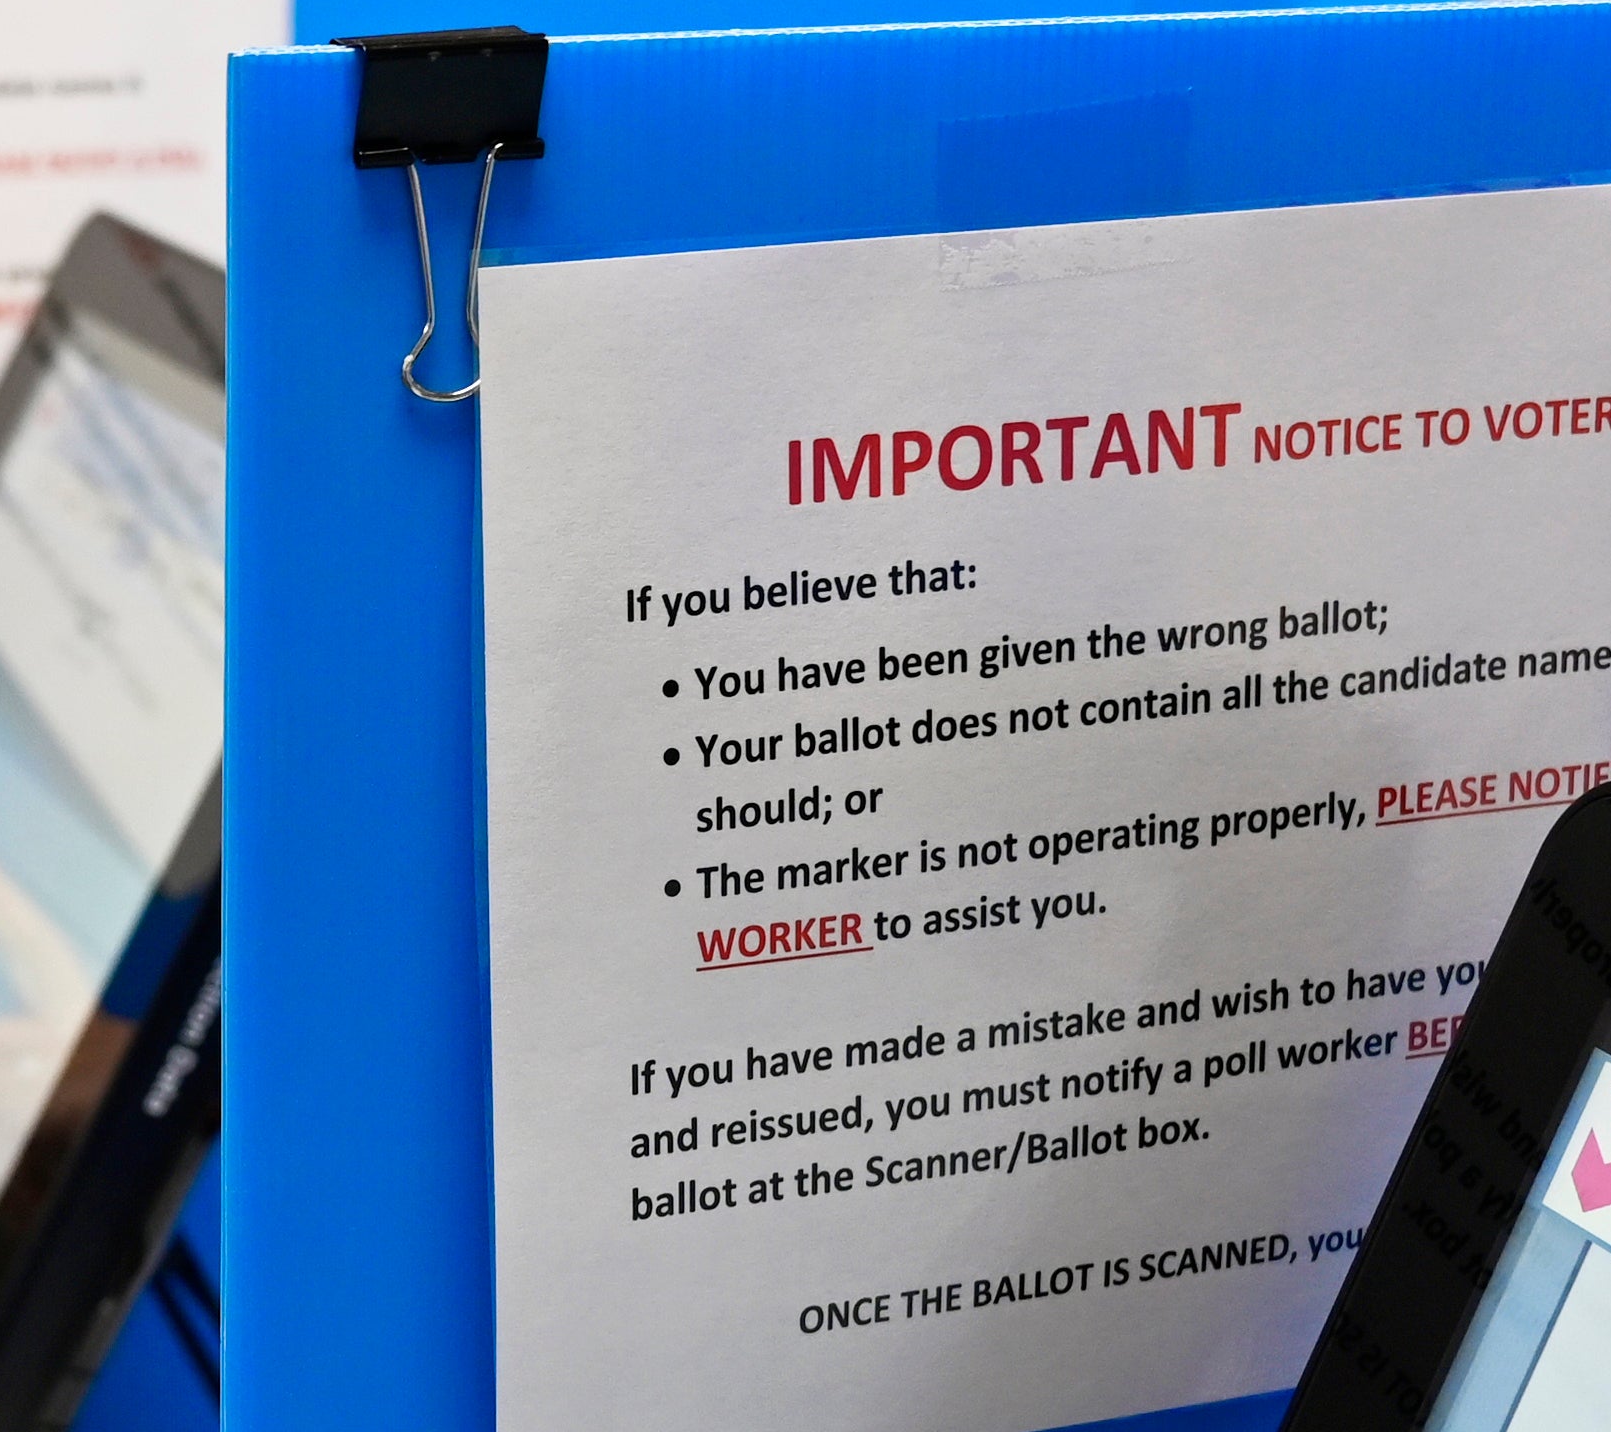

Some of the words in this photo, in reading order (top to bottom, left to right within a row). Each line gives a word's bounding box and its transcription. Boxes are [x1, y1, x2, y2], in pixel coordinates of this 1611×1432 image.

[787, 401, 1242, 507] IMPORTANT
[1253, 413, 1403, 465] NOTICE
[1414, 406, 1471, 449] TO
[626, 584, 653, 624] If
[661, 586, 730, 628] you
[742, 569, 878, 612] believe
[887, 559, 977, 597] that:
[693, 665, 765, 701] You
[777, 655, 866, 692] have
[878, 645, 968, 683] been
[979, 633, 1076, 680] given
[1086, 622, 1147, 661] the
[1156, 616, 1269, 653] wrong
[1278, 599, 1388, 641] ballot;
[694, 733, 784, 768] Your
[794, 715, 902, 758] ballot
[911, 707, 998, 746] does
[1008, 698, 1071, 735] not
[1079, 681, 1212, 727] contain
[1222, 672, 1263, 712] all
[1271, 668, 1330, 706] the
[1339, 651, 1507, 698] candidate
[695, 861, 765, 900] The
[777, 846, 910, 891] marker
[919, 839, 947, 874] is
[957, 832, 1019, 870] not
[1028, 812, 1200, 866] operating
[1210, 790, 1367, 848] properly,
[1377, 773, 1498, 815] PLEASE
[696, 784, 833, 834] should;
[843, 787, 884, 817] or
[696, 912, 864, 964] WORKER
[872, 911, 912, 942] to
[922, 894, 1021, 936] assist
[1030, 890, 1107, 931] you.
[631, 1058, 657, 1096] If
[665, 1058, 734, 1100] you
[746, 1045, 834, 1082] have
[845, 1024, 946, 1068] made
[956, 1027, 977, 1054] a
[988, 1001, 1126, 1050] mistake
[1136, 988, 1202, 1029] and
[1210, 977, 1290, 1019] wish
[1299, 977, 1336, 1008] to
[1346, 967, 1426, 1001] have
[629, 1116, 698, 1159] and
[711, 1093, 874, 1148] reissued,
[884, 1091, 950, 1132] you
[962, 1073, 1052, 1114] must
[1060, 1055, 1164, 1100] notify
[1173, 1058, 1192, 1085] a
[1203, 1039, 1267, 1089] poll
[1276, 1027, 1399, 1070] worker
[632, 1178, 738, 1222] ballot
[747, 1171, 785, 1205] at
[793, 1161, 855, 1198] the
[865, 1122, 1129, 1188] Scanner/Ballot
[1137, 1115, 1210, 1150] box.
[798, 1293, 891, 1335] ONCE
[900, 1282, 963, 1319] THE
[972, 1262, 1095, 1309] BALLOT
[1103, 1257, 1131, 1288] IS
[1138, 1233, 1298, 1283] SCANNED,
[1307, 1227, 1363, 1263] you
